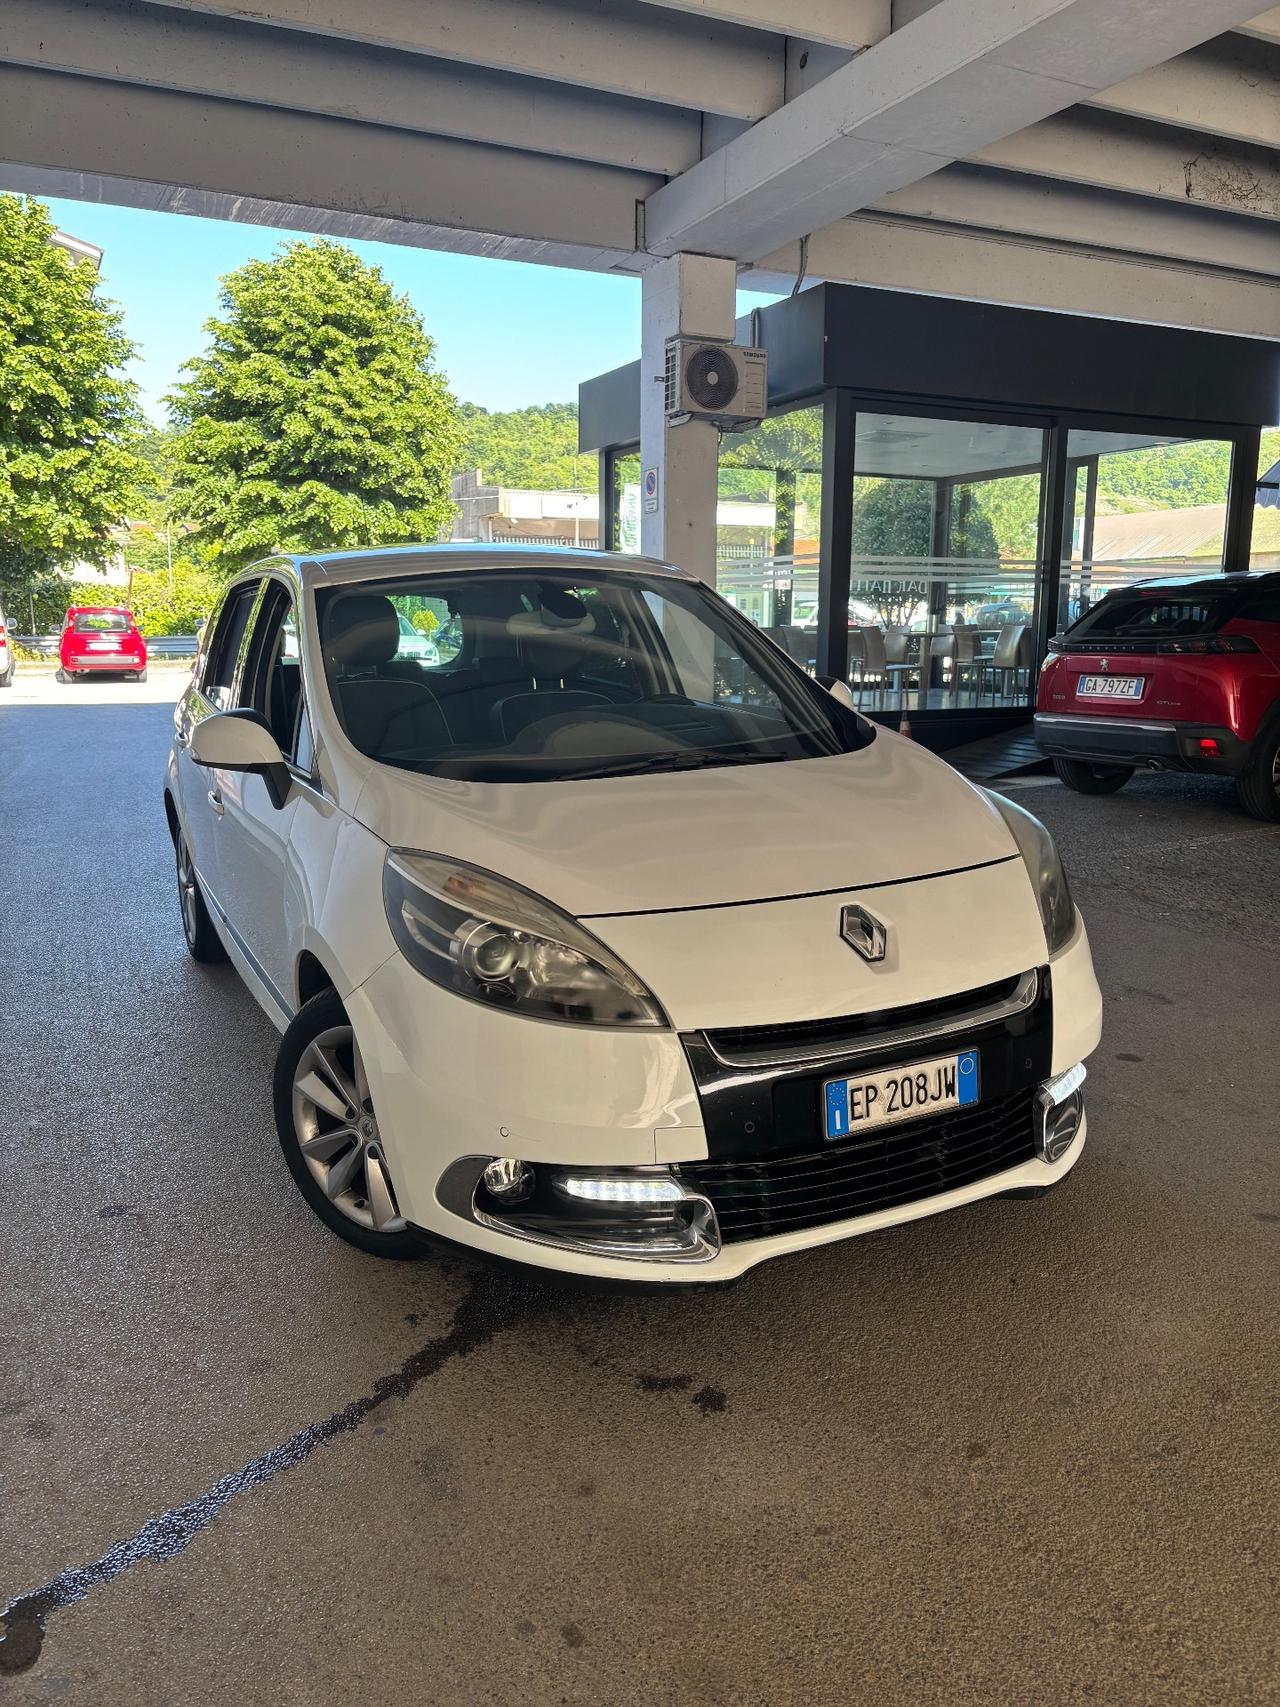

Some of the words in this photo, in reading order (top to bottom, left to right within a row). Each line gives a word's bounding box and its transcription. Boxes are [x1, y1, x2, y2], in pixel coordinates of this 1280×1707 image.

[1085, 678, 1098, 693] GA
[1100, 679, 1136, 694] 797ZF
[850, 1084, 878, 1121] EP
[885, 1065, 957, 1113] 208JW
